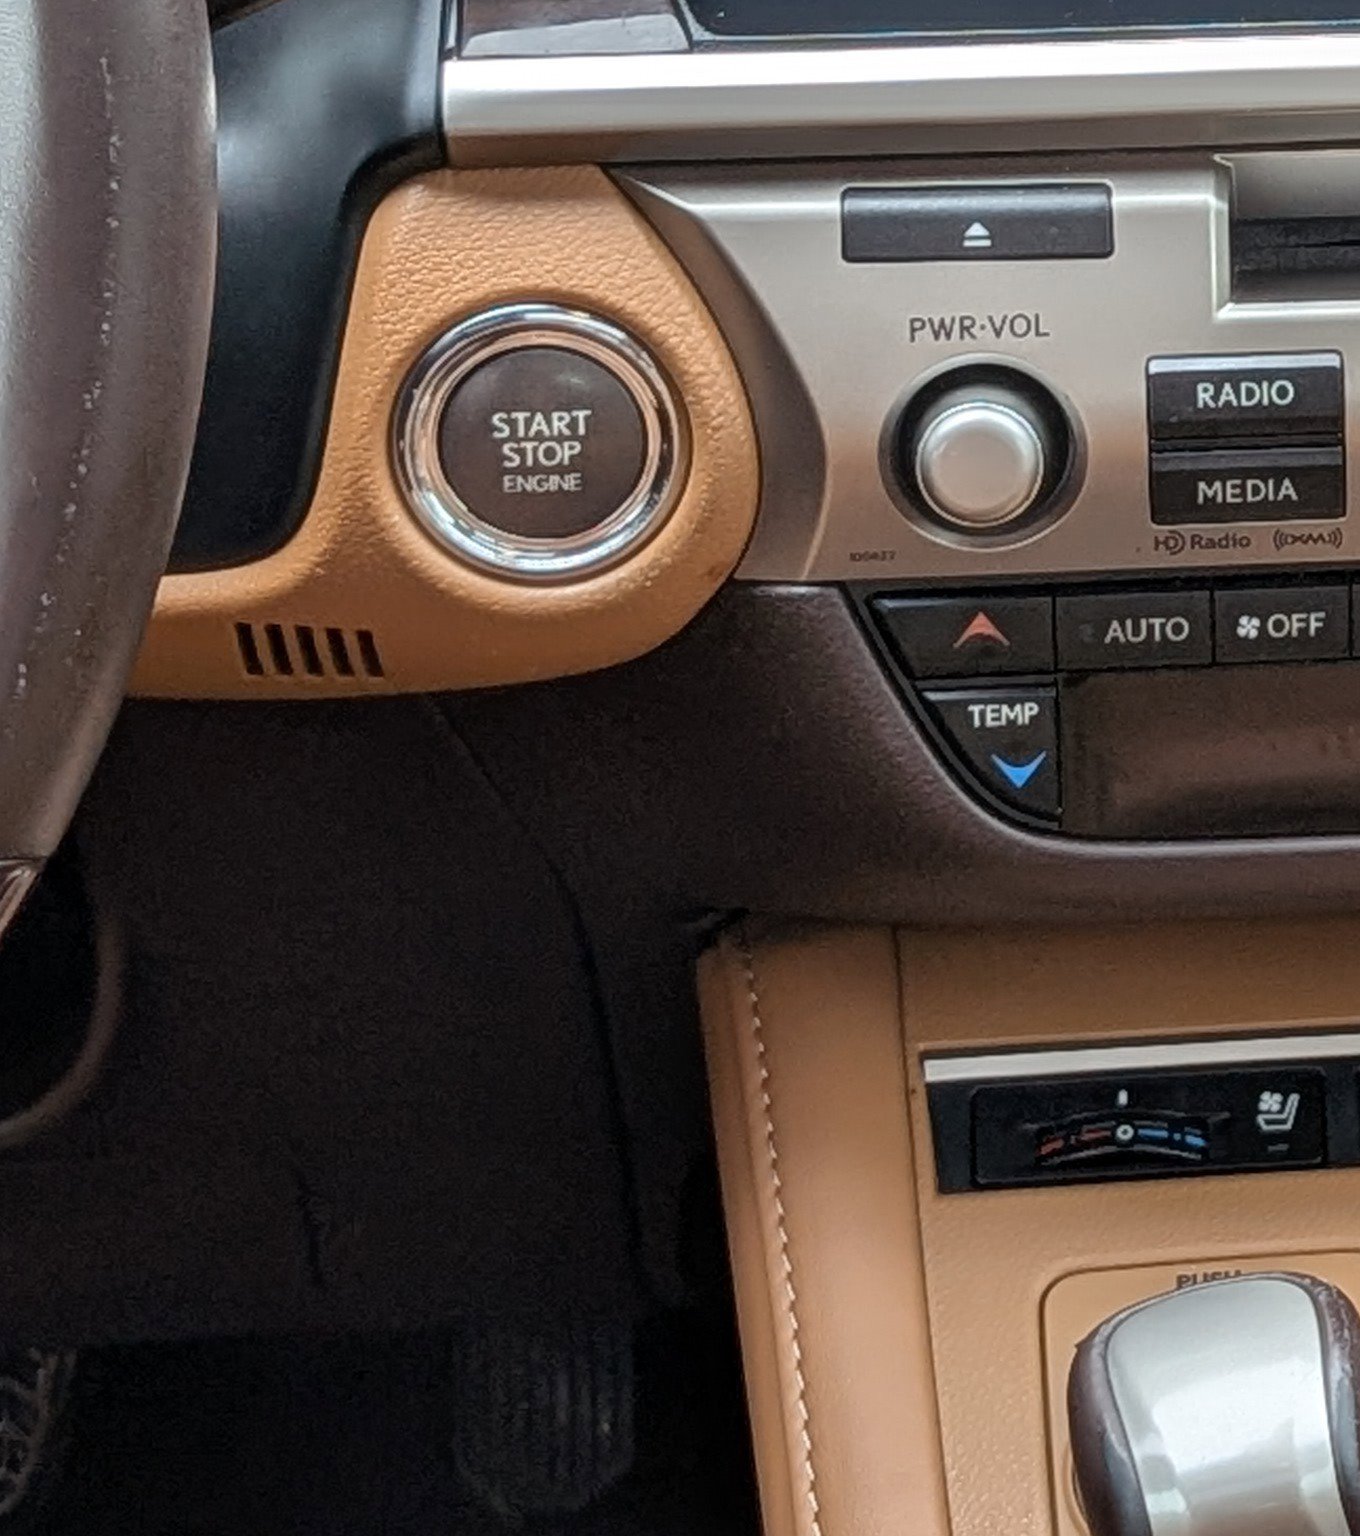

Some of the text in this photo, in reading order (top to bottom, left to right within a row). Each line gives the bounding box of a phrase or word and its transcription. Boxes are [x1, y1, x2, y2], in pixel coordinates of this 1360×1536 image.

[1196, 379, 1295, 409] RADIO
[491, 409, 592, 440] START
[502, 440, 582, 469] STOP
[503, 472, 583, 494] ENGINE
[1197, 476, 1299, 506] MEDIA
[1190, 532, 1252, 550] Radio
[1103, 617, 1190, 646] AUTO
[1266, 610, 1327, 639] OFF
[967, 701, 1040, 730] TEMP
